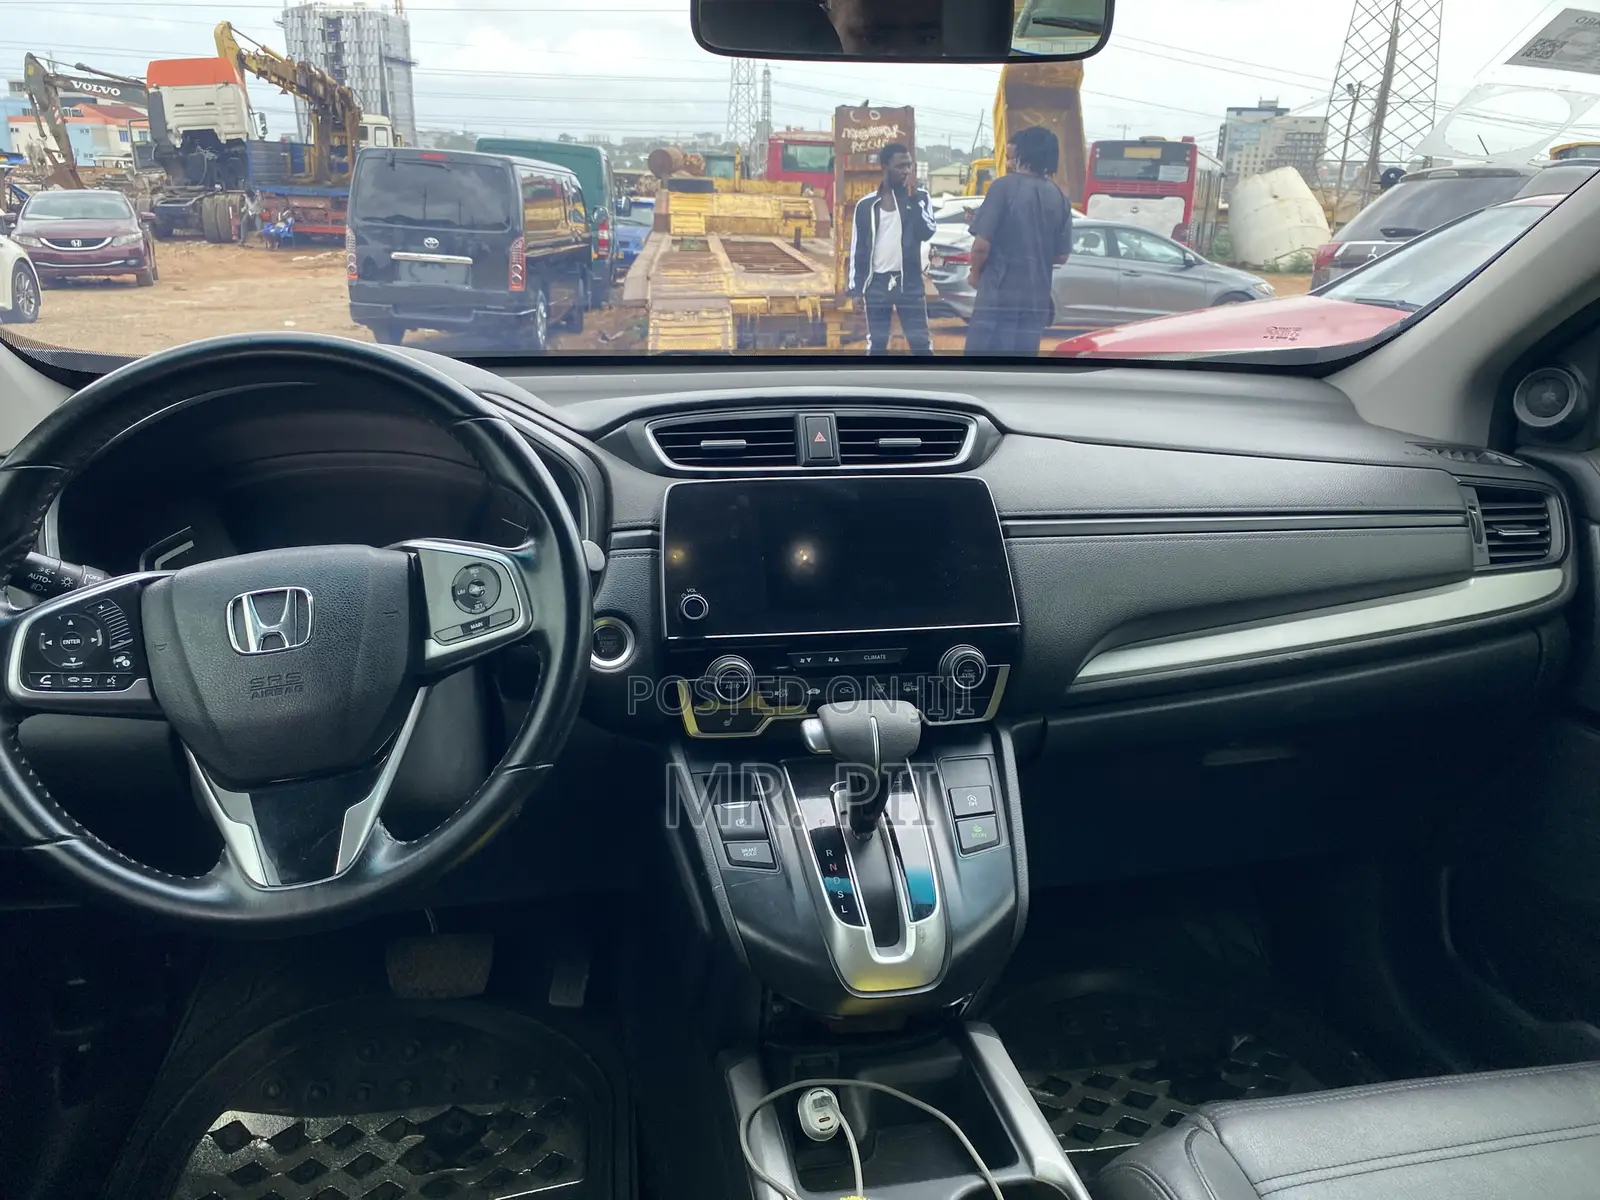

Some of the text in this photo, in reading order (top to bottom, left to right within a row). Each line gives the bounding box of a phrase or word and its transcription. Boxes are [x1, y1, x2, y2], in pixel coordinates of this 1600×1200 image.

[70, 80, 121, 96] VOLVO
[28, 572, 49, 583] AUTO
[863, 653, 887, 661] CLIMATE
[825, 849, 833, 857] R
[829, 863, 837, 871] N
[833, 876, 841, 885] D
[837, 890, 845, 899] S
[841, 904, 848, 914] L
